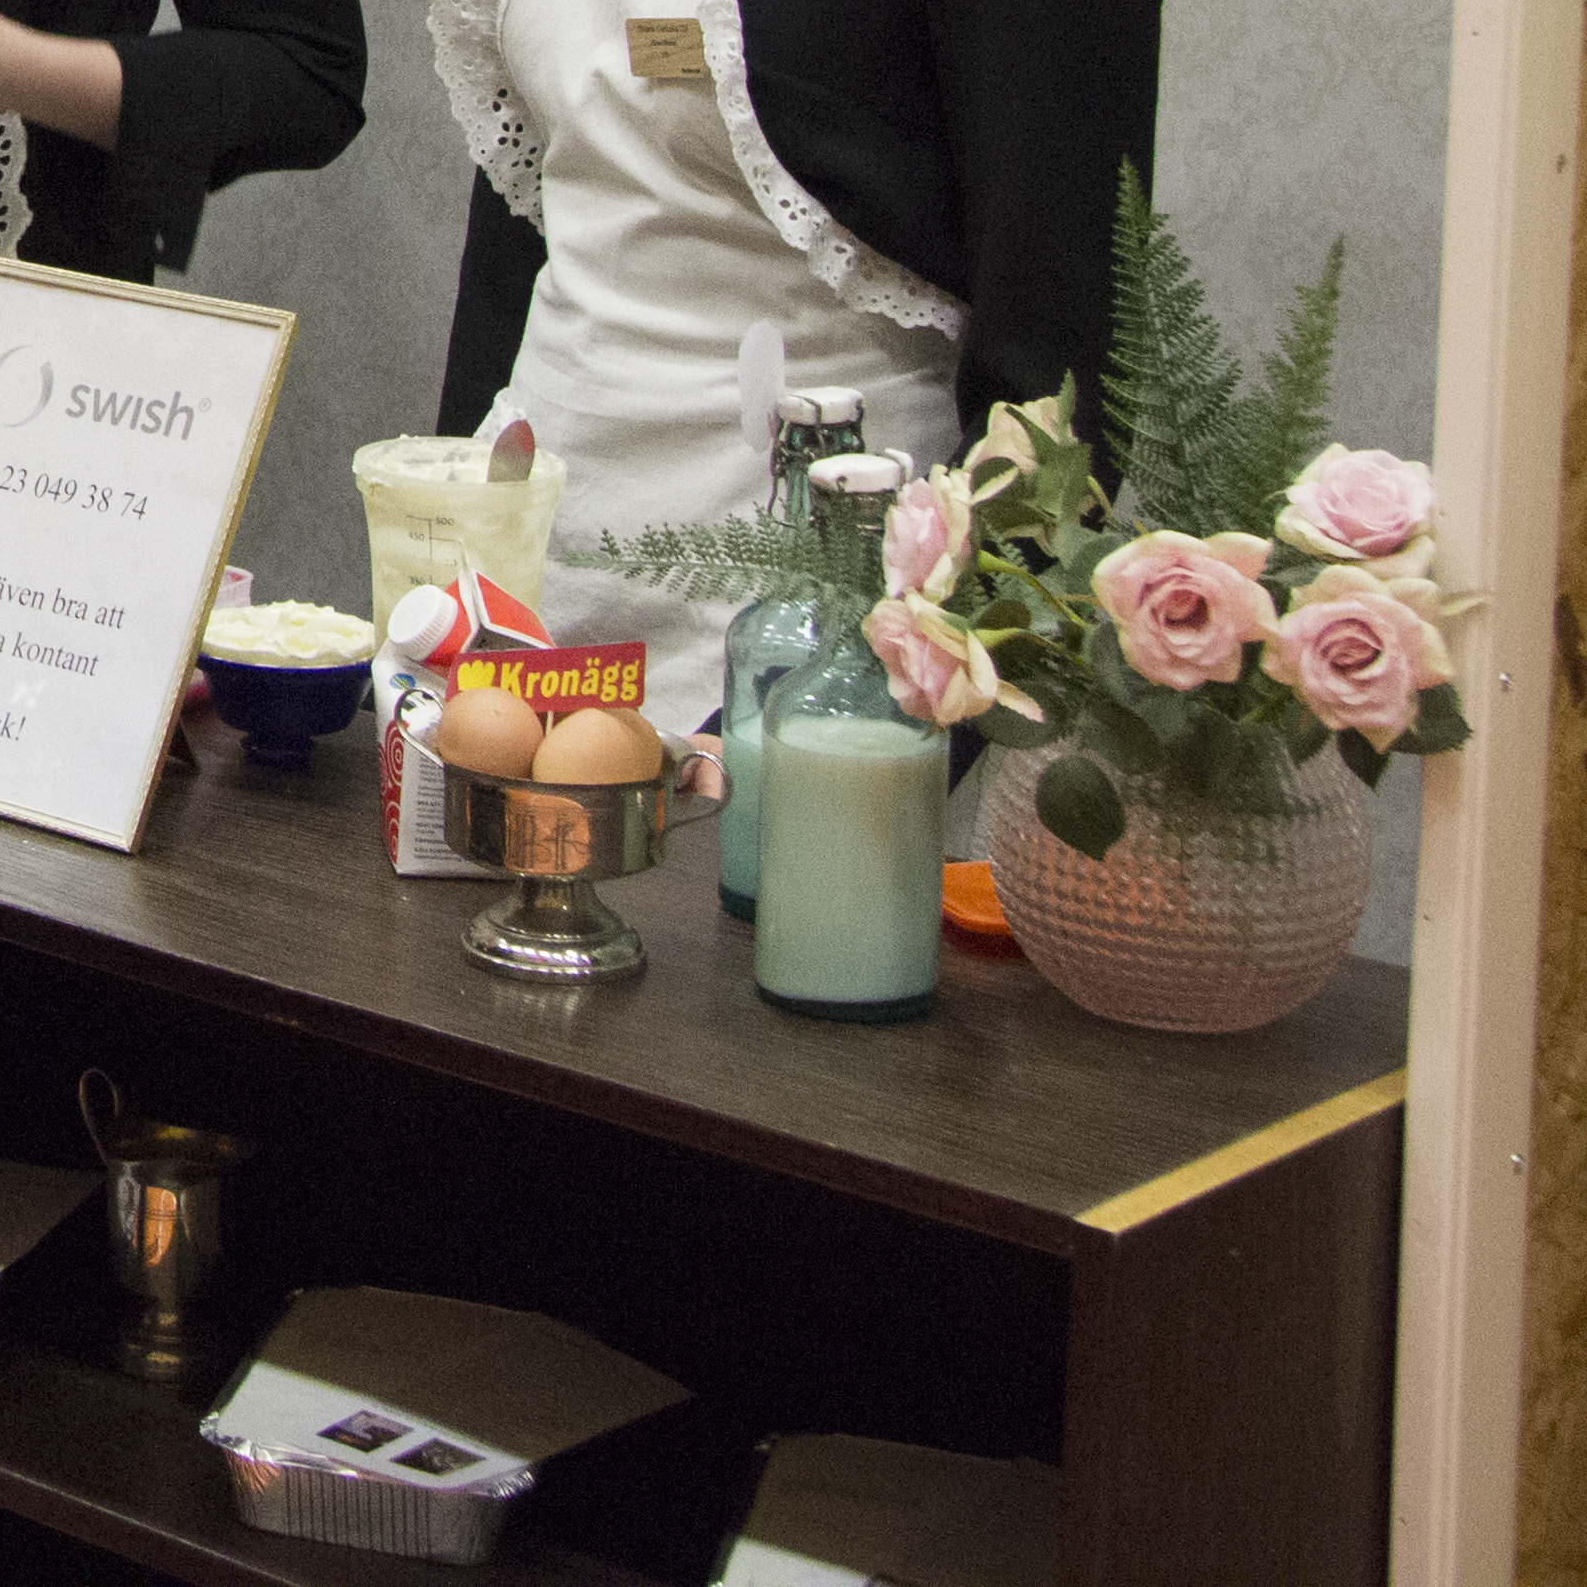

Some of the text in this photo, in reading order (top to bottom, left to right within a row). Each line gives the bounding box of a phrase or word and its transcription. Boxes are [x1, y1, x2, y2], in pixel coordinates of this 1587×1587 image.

[65, 384, 195, 441] swish
[34, 473, 77, 504] 049
[81, 484, 113, 513] 38
[120, 491, 148, 520] 74
[51, 588, 88, 620] bra
[94, 605, 127, 629] att
[12, 632, 99, 677] kontant
[500, 657, 642, 702] Kronägg
